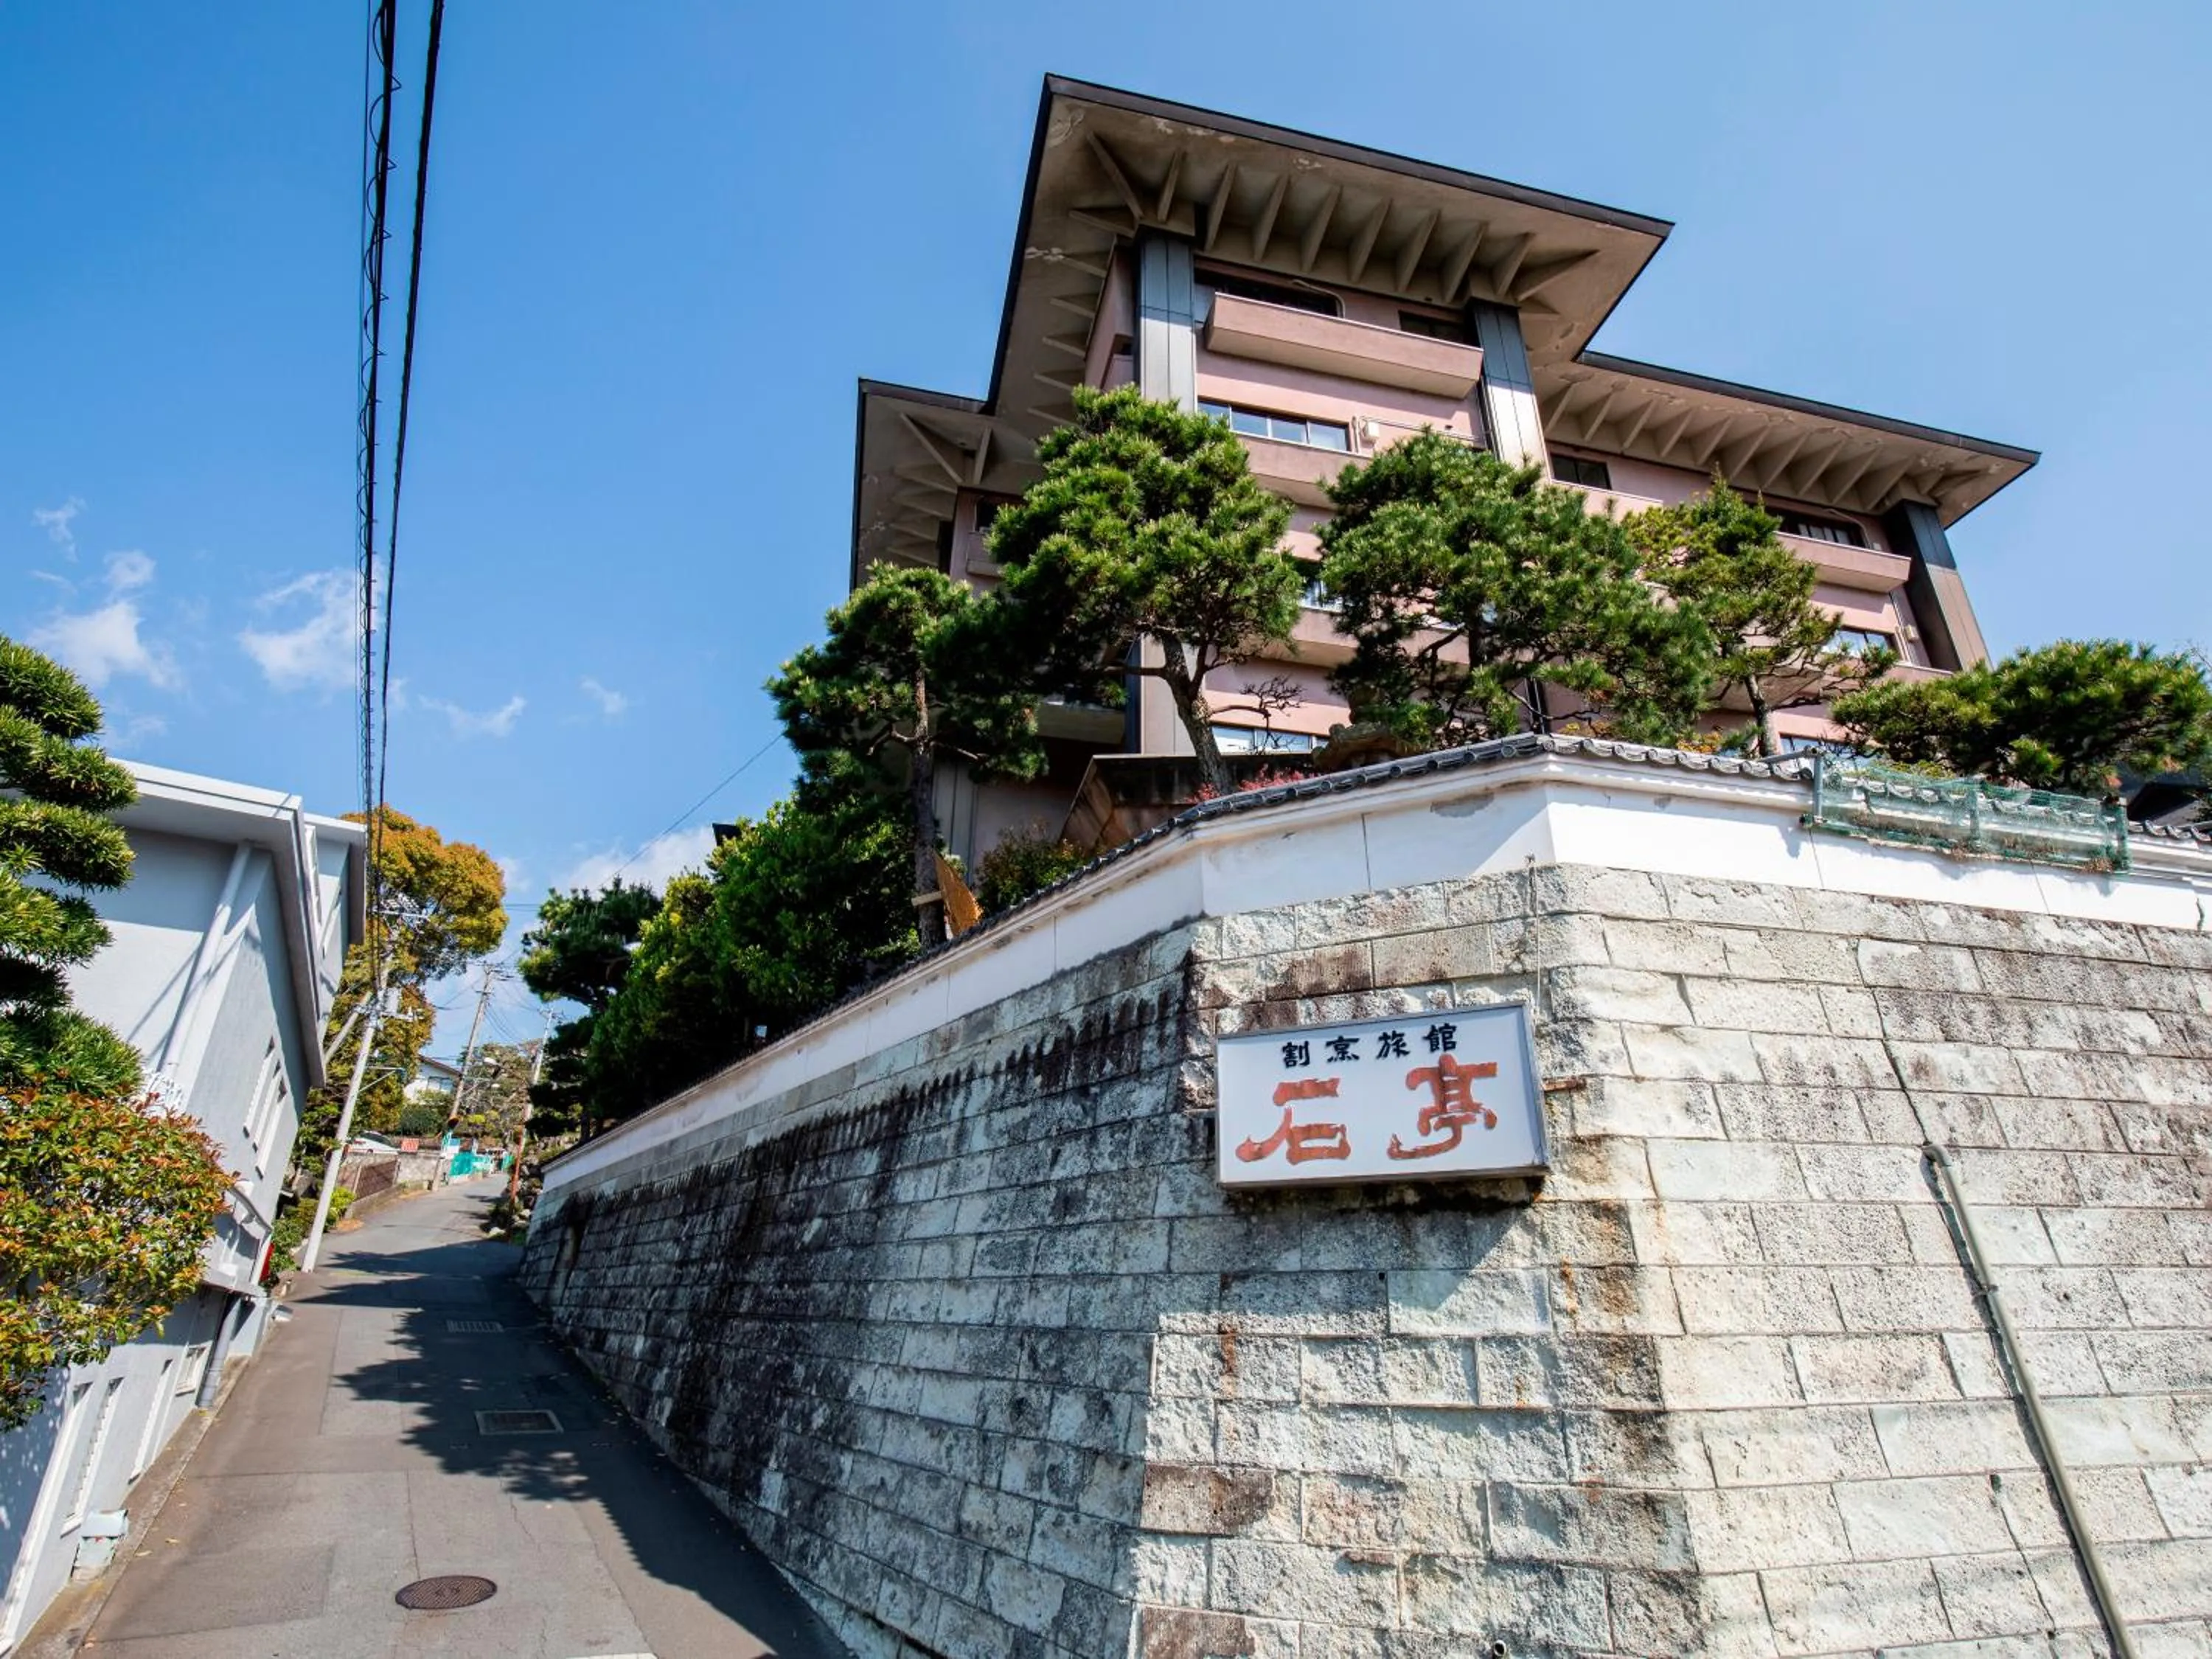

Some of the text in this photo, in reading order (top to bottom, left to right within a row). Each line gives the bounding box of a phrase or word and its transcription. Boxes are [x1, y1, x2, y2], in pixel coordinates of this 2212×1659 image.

[1281, 1023, 1457, 1068] 割烹旅館
[1235, 1053, 1498, 1165] 石亭
